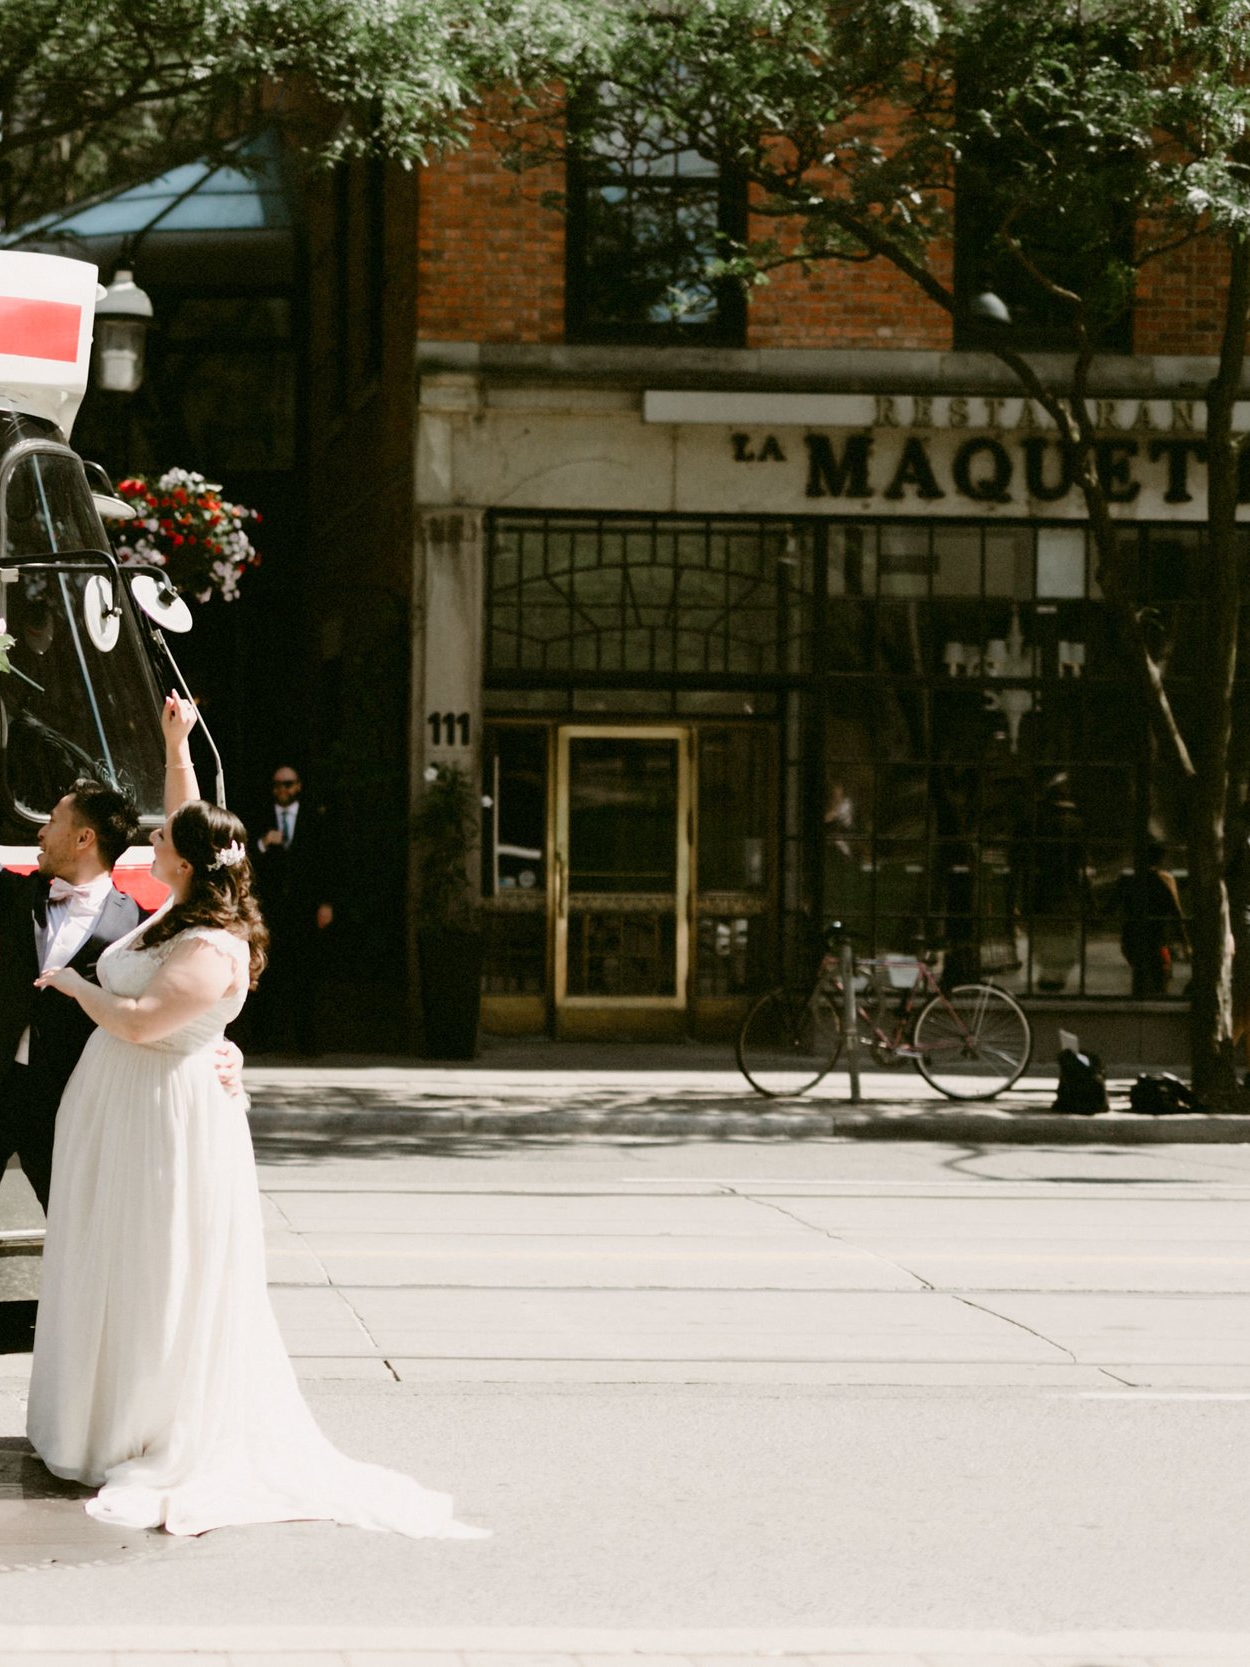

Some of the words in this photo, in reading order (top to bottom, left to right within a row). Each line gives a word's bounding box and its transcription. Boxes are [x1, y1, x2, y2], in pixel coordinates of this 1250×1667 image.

[874, 397, 1195, 430] RESTARAN
[731, 432, 787, 462] LA
[804, 433, 1250, 504] MAQUET
[428, 711, 470, 746] 111
